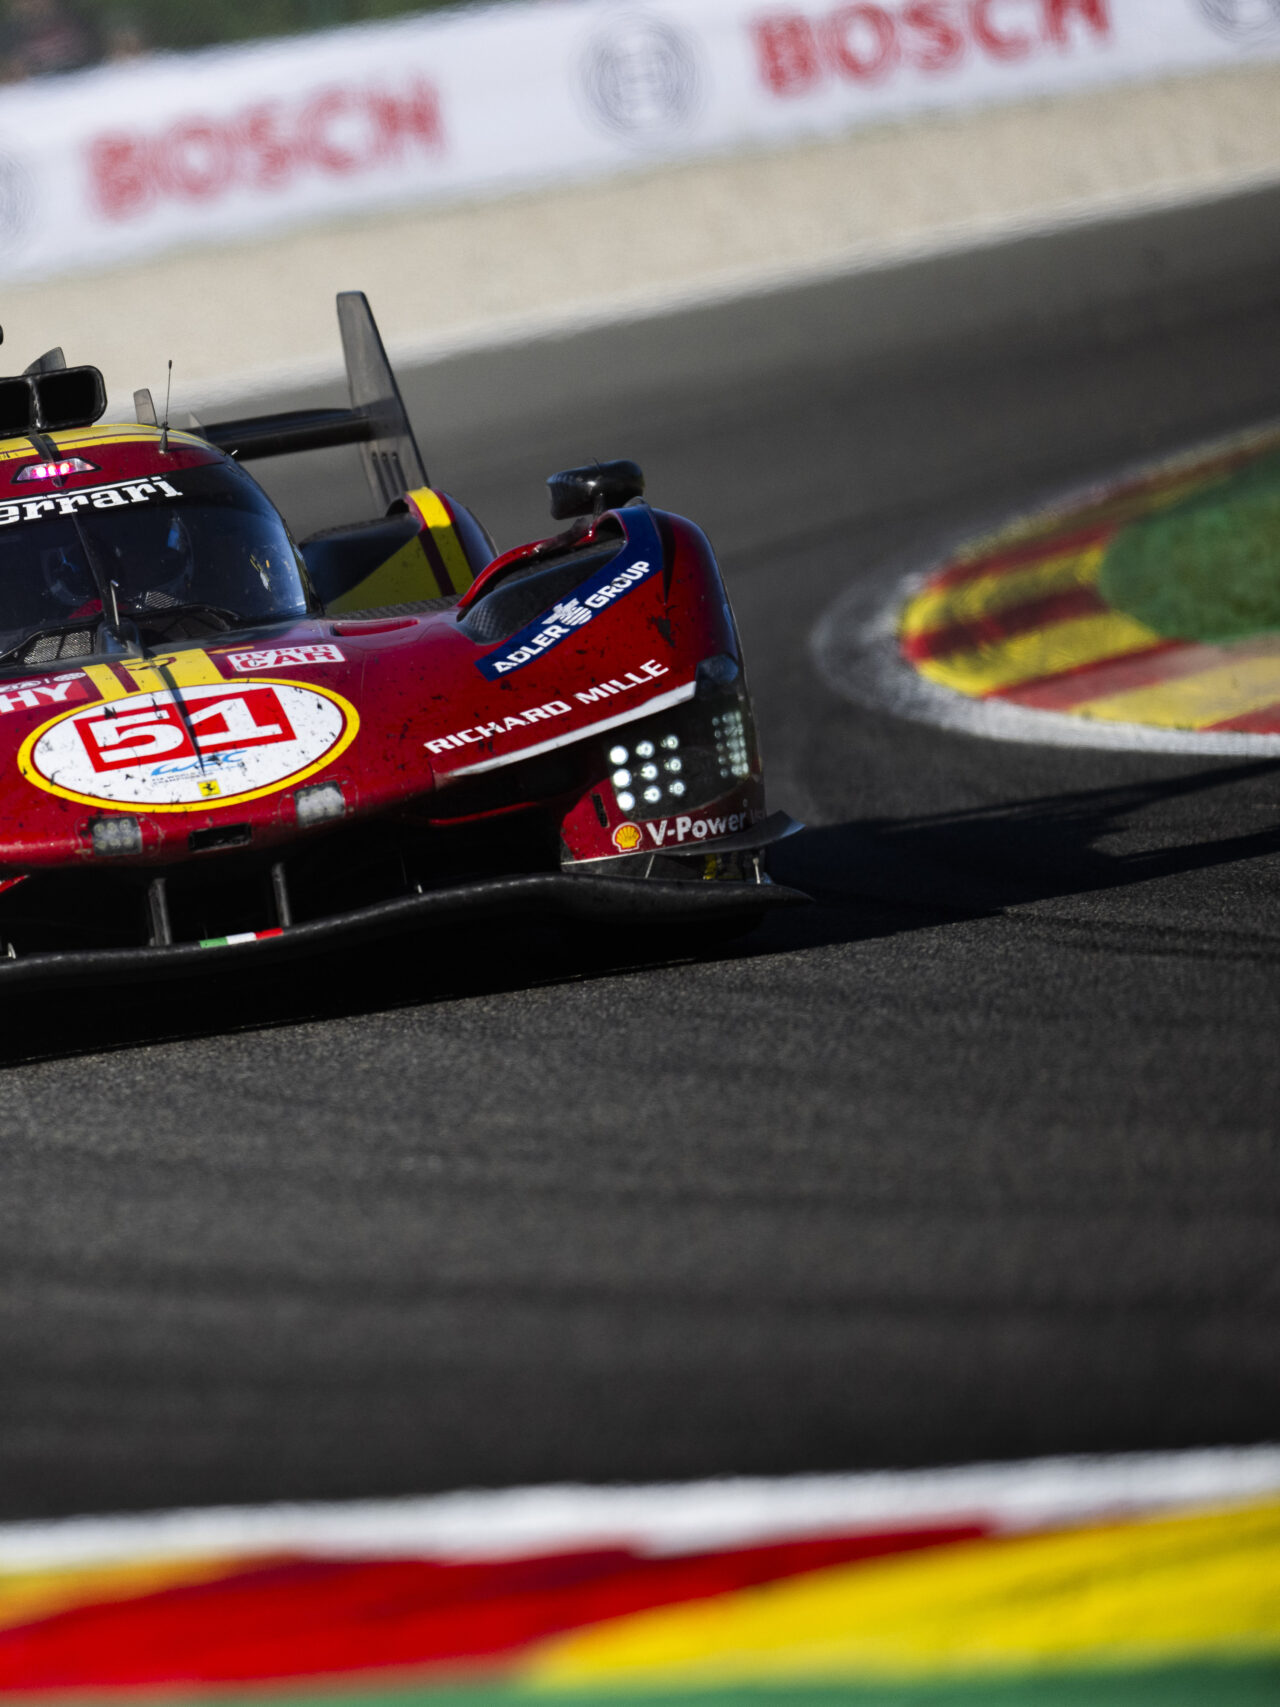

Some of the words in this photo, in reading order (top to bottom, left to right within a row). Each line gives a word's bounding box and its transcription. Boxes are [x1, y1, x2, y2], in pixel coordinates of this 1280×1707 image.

[84, 78, 446, 220] BOSCH
[492, 624, 570, 673] ADLER
[584, 561, 651, 609] GROUP
[239, 651, 337, 668] CAR
[87, 697, 284, 763] 51
[423, 700, 573, 753] RICHARD
[573, 659, 670, 704] MILLE
[646, 811, 747, 846] V-Power
